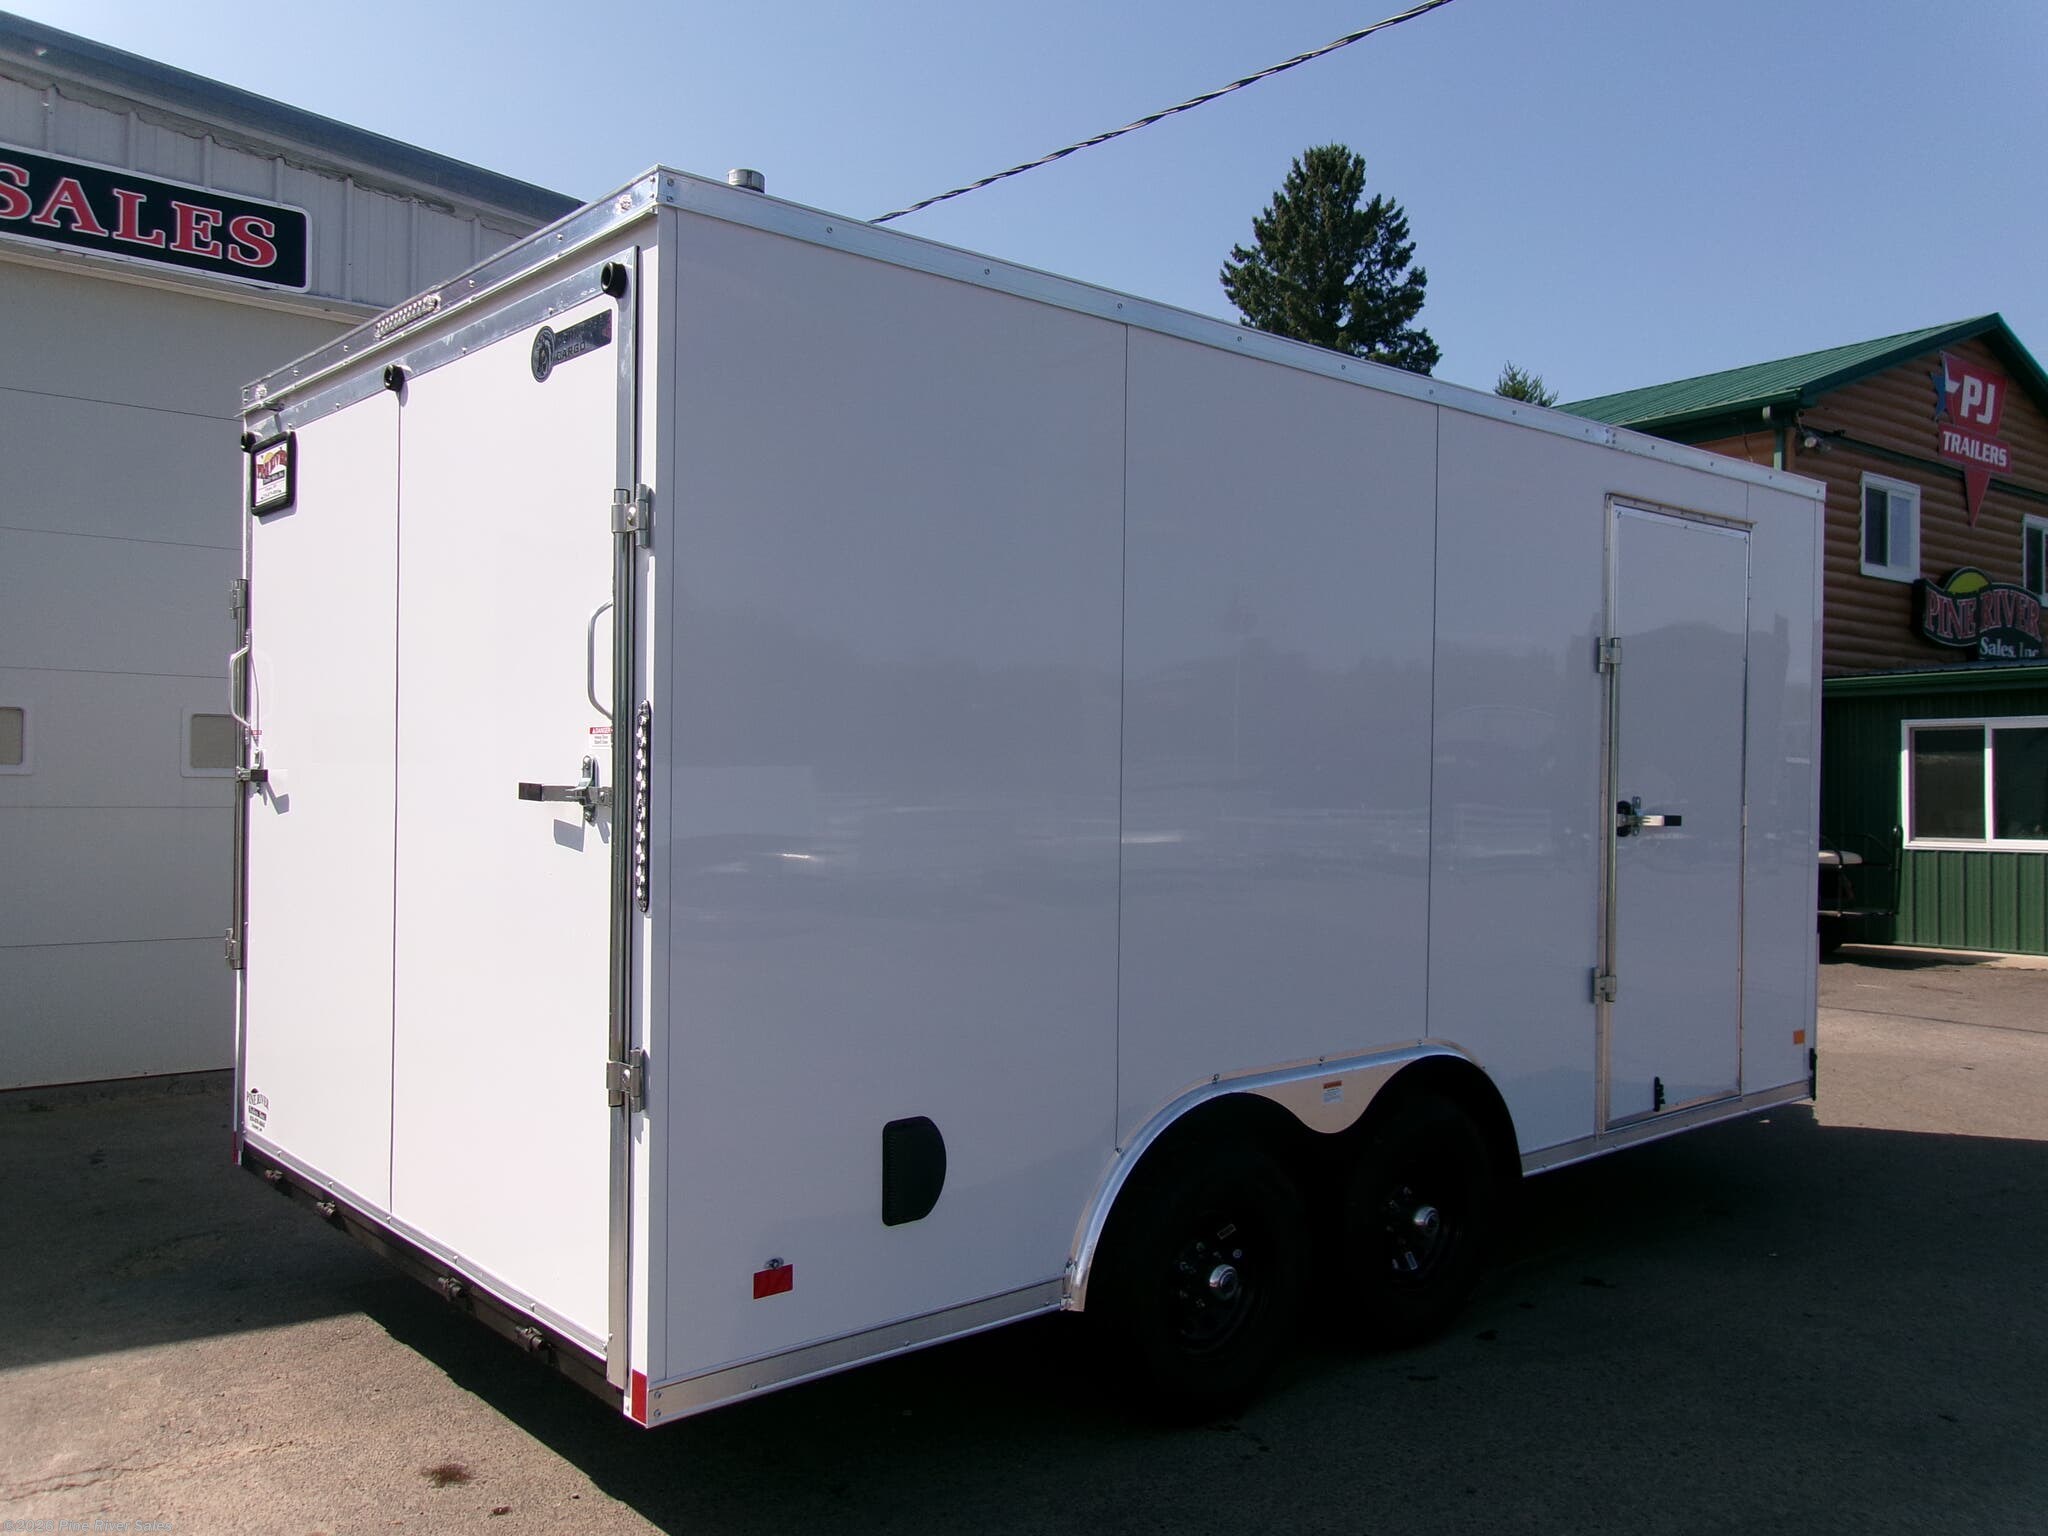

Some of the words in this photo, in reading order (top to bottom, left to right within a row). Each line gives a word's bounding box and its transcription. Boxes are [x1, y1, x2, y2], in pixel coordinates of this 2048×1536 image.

[0, 162, 278, 268] SALES
[556, 340, 586, 361] CARGO
[1960, 374, 1996, 425] PJ
[1943, 430, 2008, 467] TRAILERS
[1925, 586, 1977, 640] PINE
[1981, 588, 2042, 643] RIVER
